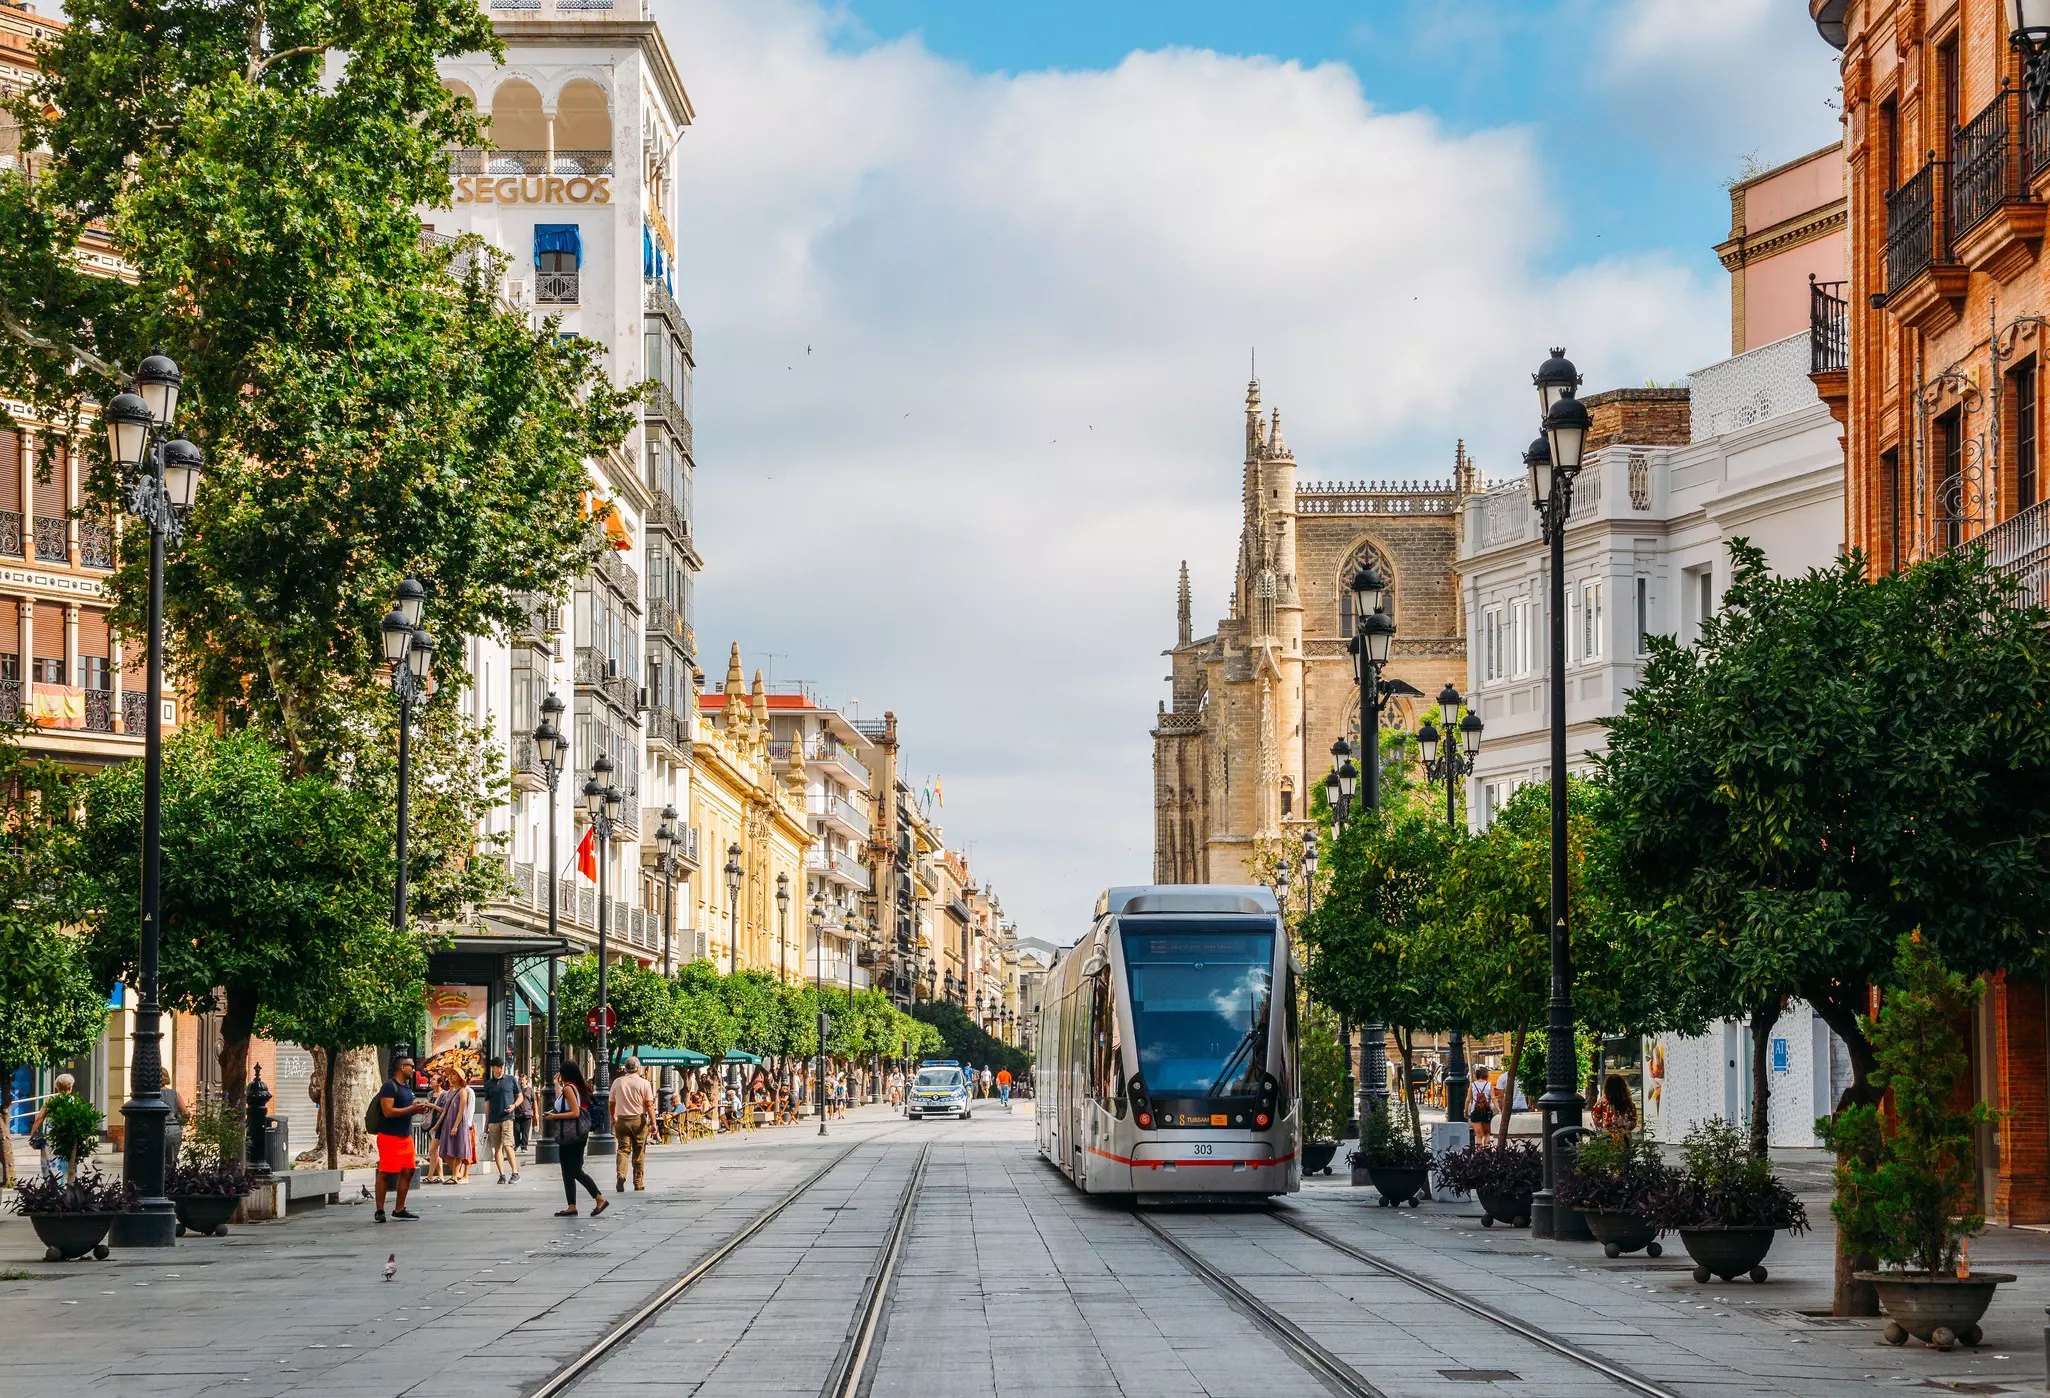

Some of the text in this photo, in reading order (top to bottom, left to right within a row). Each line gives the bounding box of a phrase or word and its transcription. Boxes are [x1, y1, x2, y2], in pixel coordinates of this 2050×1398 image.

[457, 177, 611, 204] SEGUROS
[1775, 1040, 1785, 1053] AT
[1194, 1144, 1212, 1154] 303
